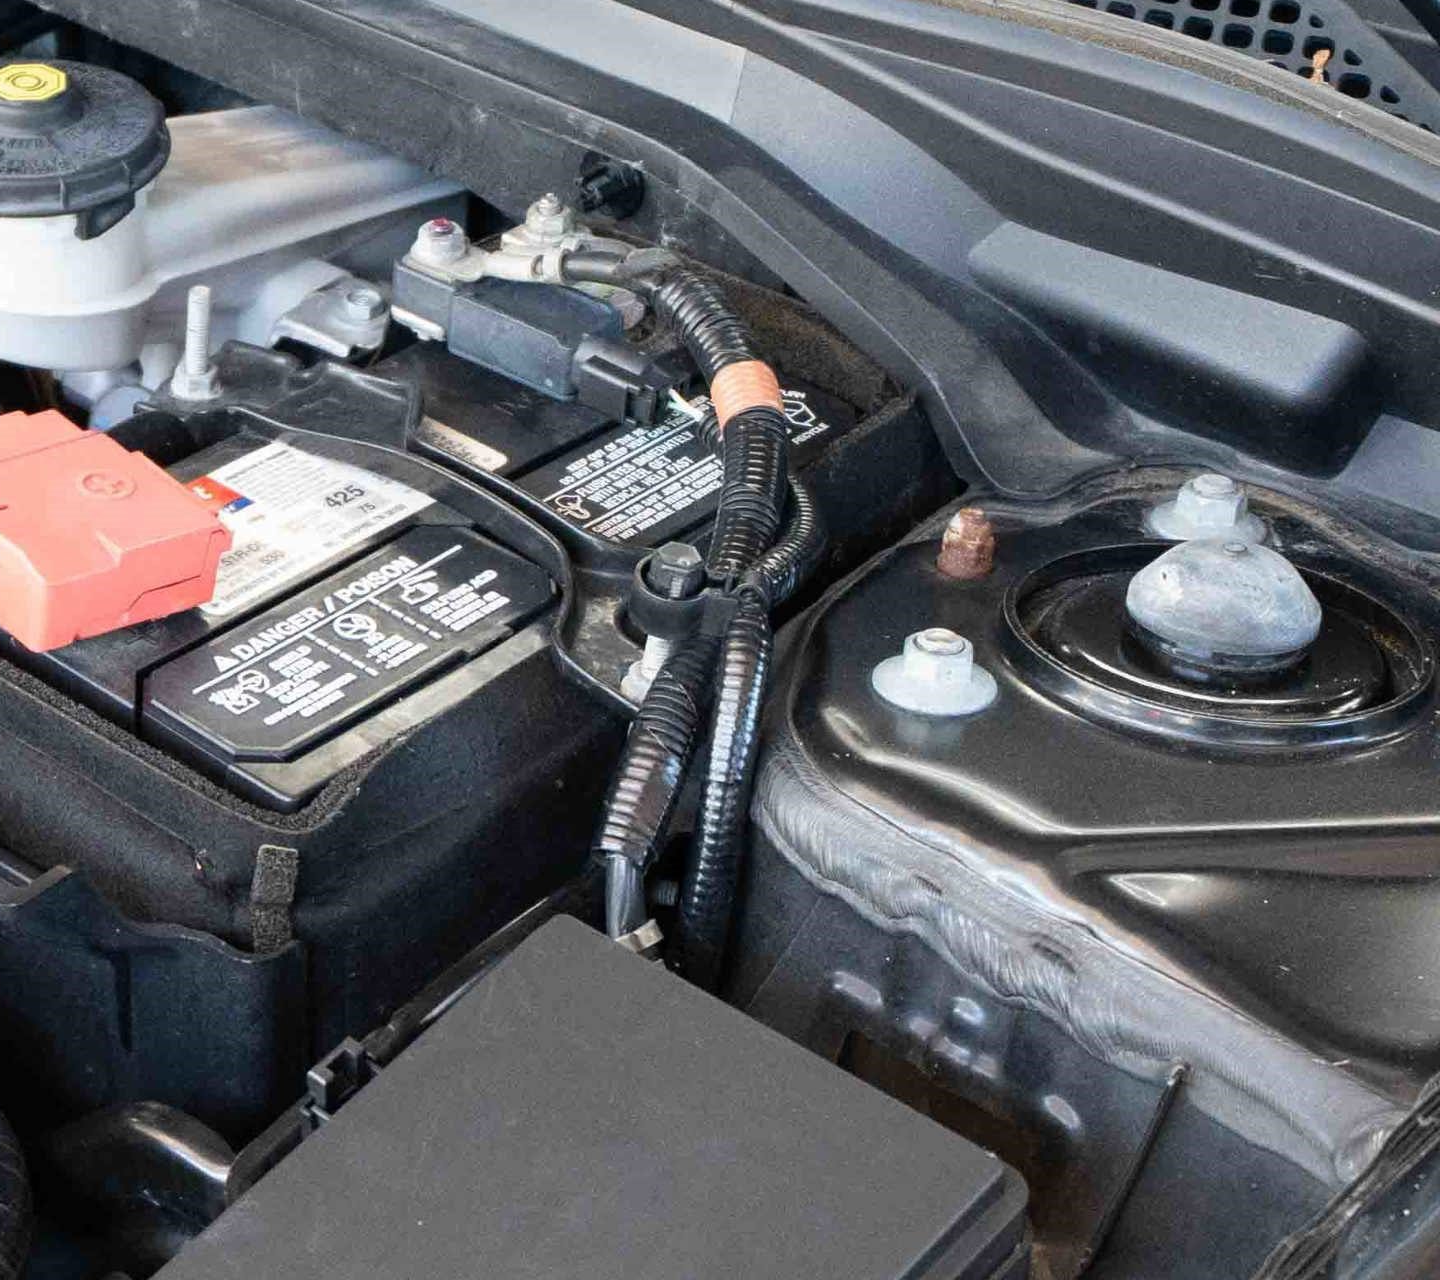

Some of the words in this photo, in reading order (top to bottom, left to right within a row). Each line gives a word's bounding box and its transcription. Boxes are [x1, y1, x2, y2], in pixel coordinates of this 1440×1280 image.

[575, 476, 611, 496] FLUSH
[605, 462, 636, 479] EYES
[631, 431, 695, 465] IMMEDIATELY
[586, 485, 618, 503] WITH
[647, 456, 671, 469] GET
[599, 483, 645, 508] MEDICAL
[640, 470, 669, 486] HELP
[665, 457, 693, 472] FAST
[326, 485, 364, 507] 425
[358, 503, 375, 512] 75
[618, 528, 638, 539] NOT
[230, 606, 325, 661] DANGER
[323, 596, 336, 613] /
[334, 556, 418, 604] POISON
